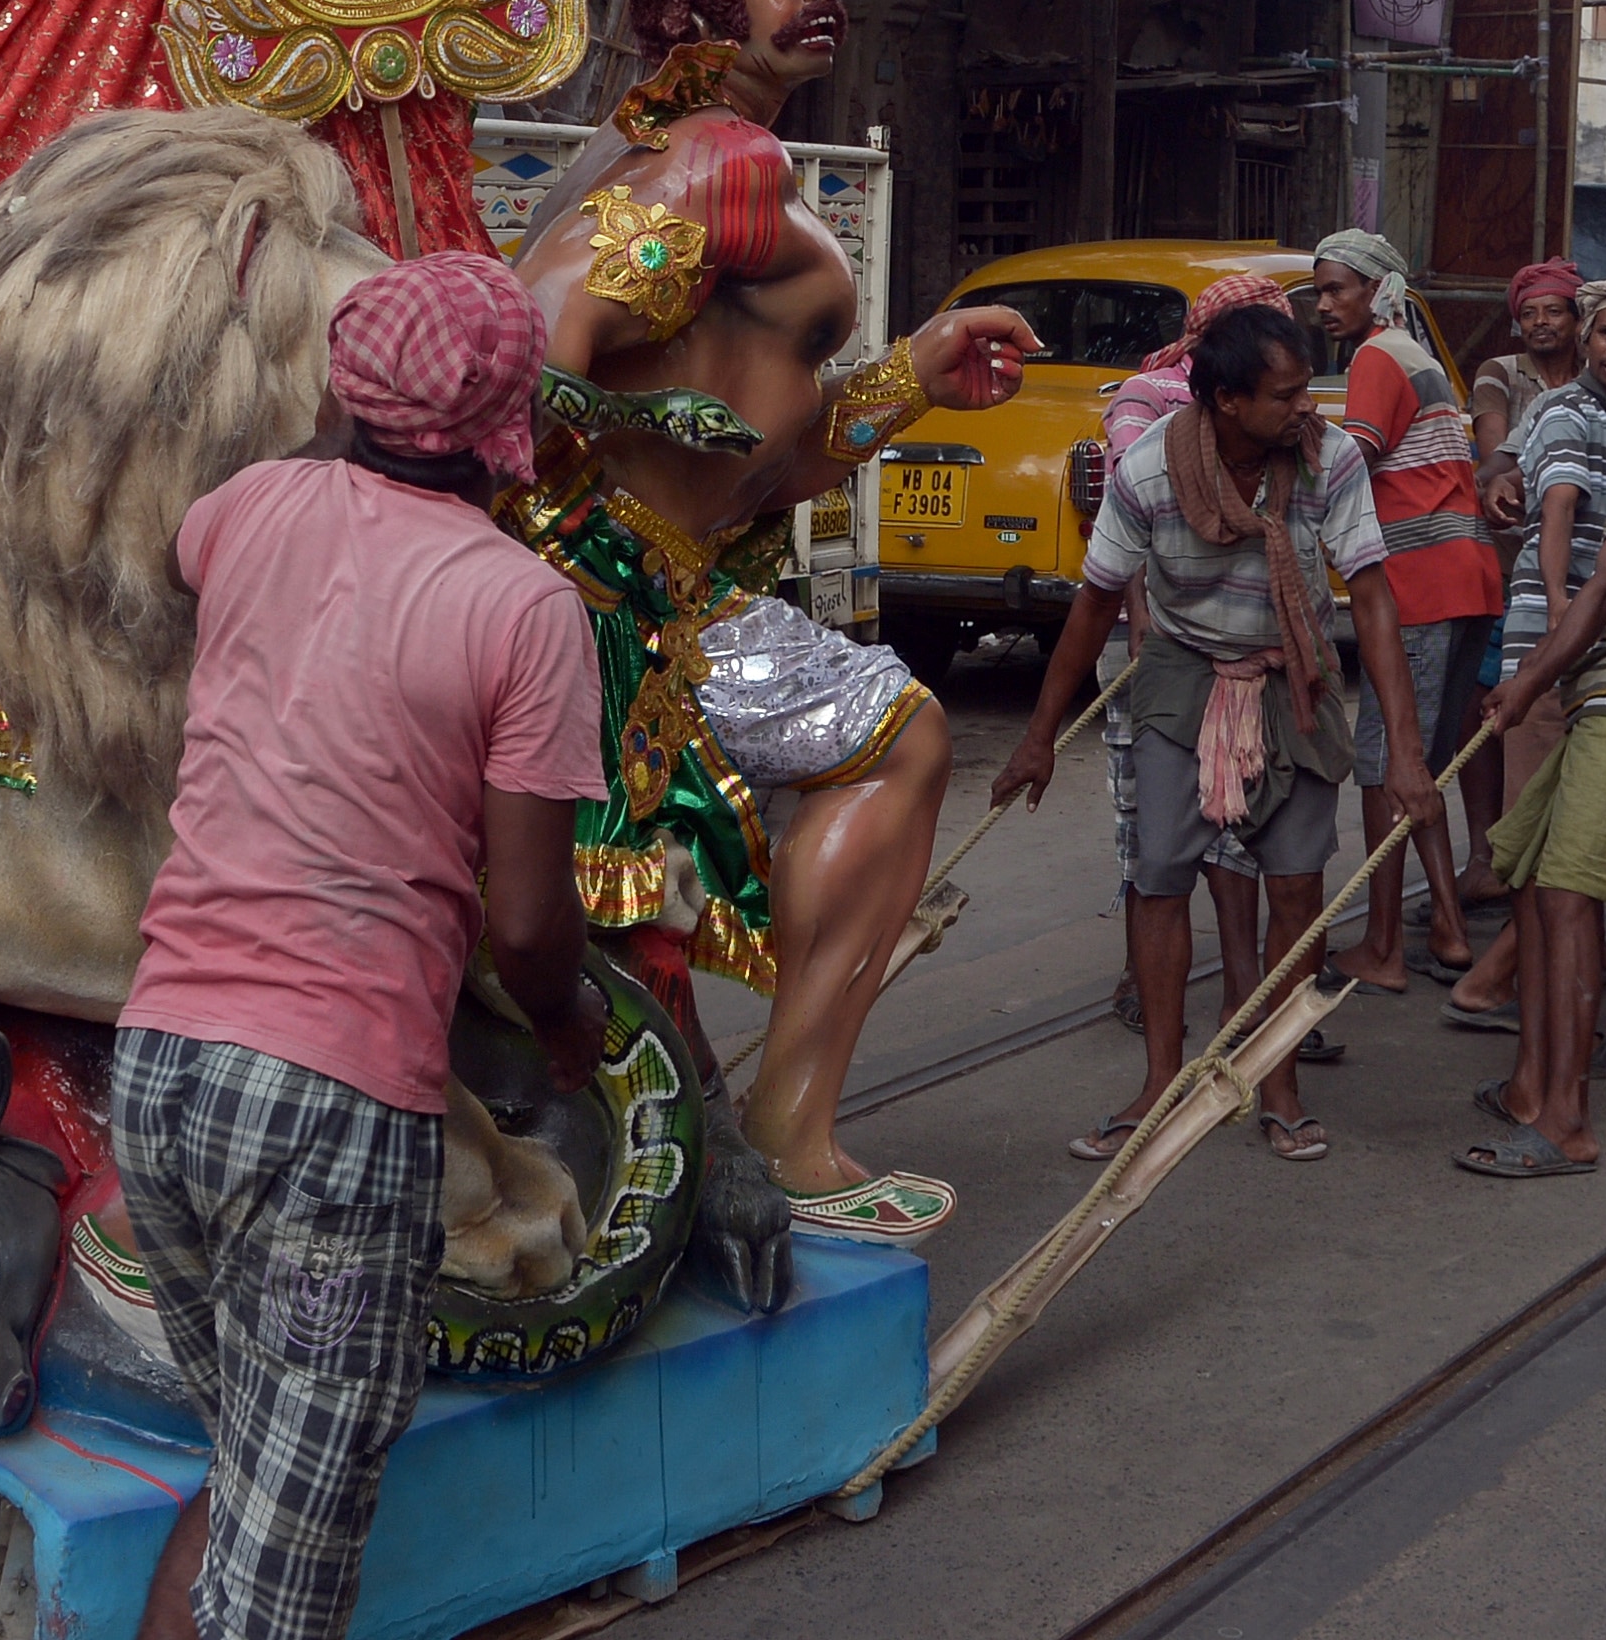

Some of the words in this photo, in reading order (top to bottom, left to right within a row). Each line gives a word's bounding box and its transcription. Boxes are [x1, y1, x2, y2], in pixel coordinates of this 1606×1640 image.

[902, 468, 923, 491] WB
[931, 469, 953, 493] 04
[893, 493, 904, 514] F
[908, 494, 952, 516] 3905
[986, 522, 1034, 530] CLASSIC
